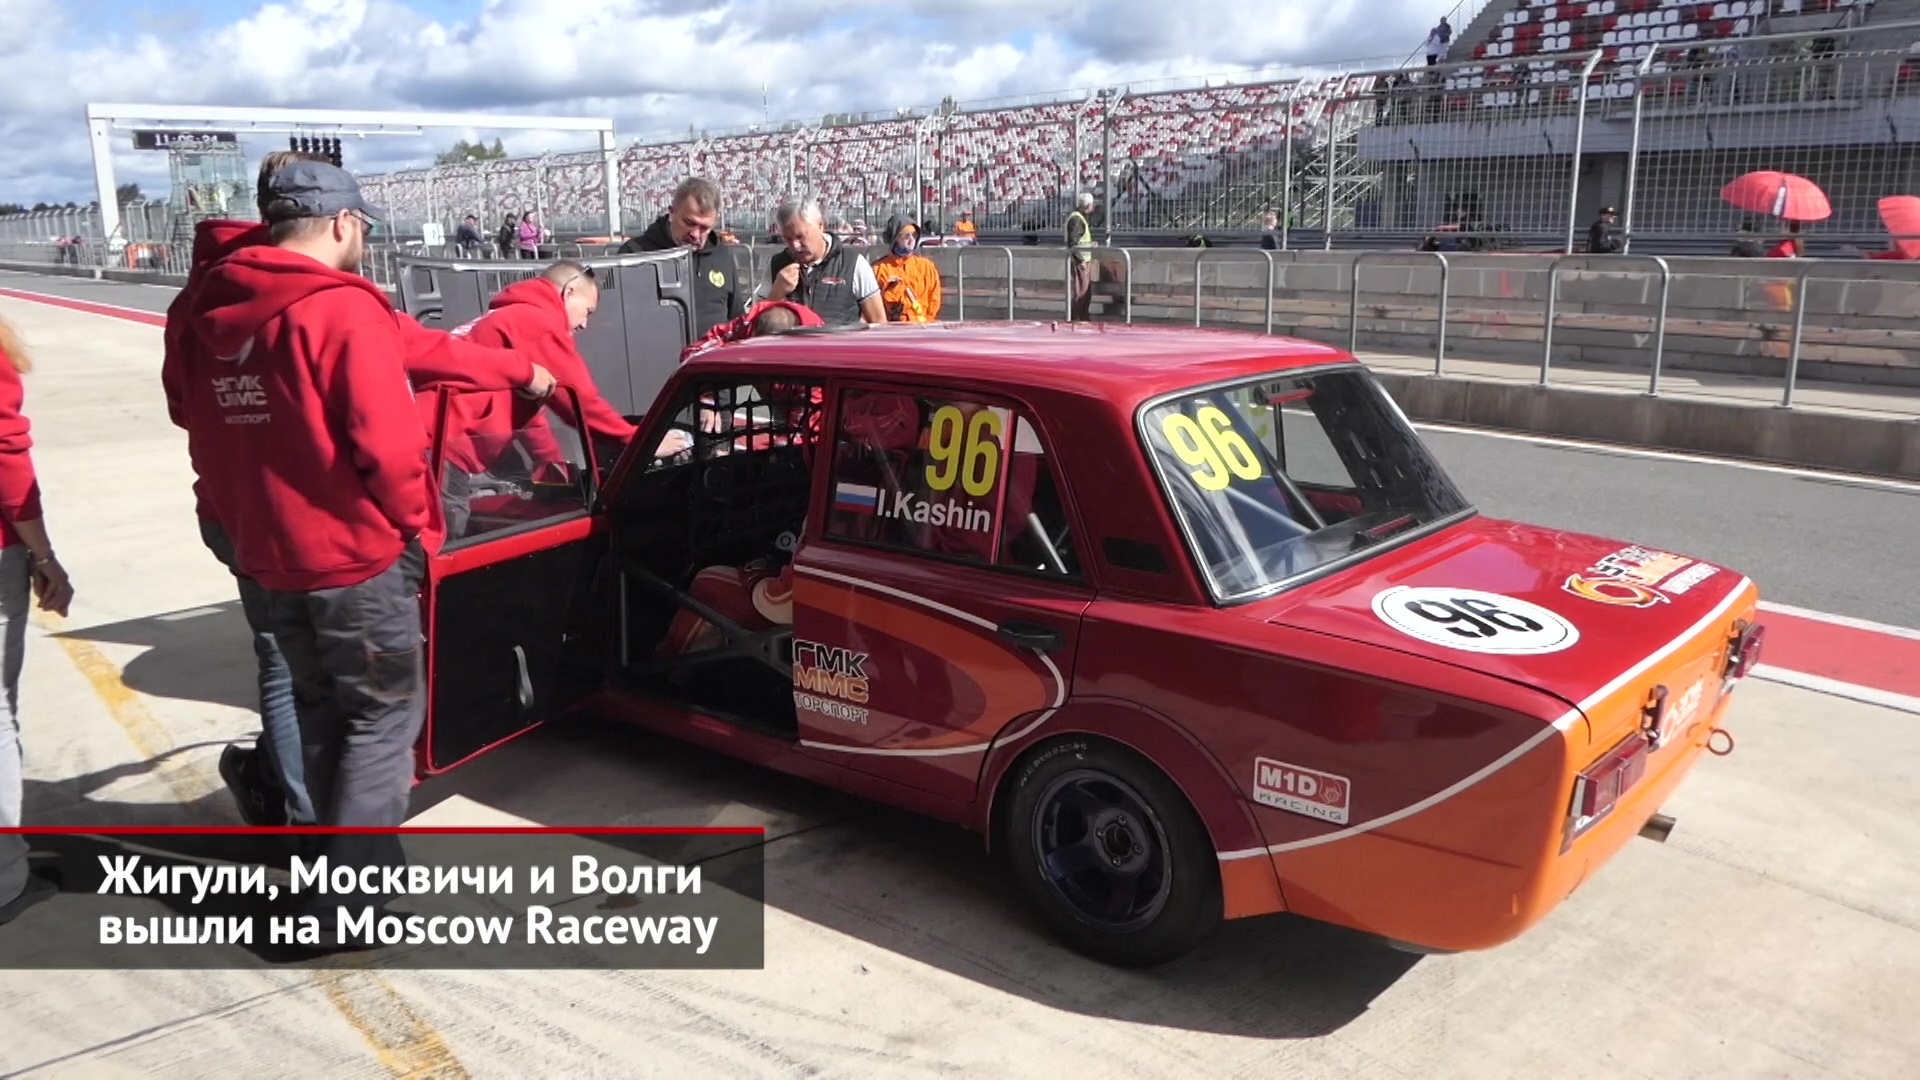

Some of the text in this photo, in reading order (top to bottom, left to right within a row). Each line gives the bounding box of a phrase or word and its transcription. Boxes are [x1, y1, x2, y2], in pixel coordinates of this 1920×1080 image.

[925, 405, 1001, 496] 96
[1162, 406, 1262, 491] 96
[877, 489, 991, 532] I.Kashin
[1404, 597, 1543, 638] 96
[1261, 765, 1317, 797] M1D
[1259, 793, 1342, 820] RACING
